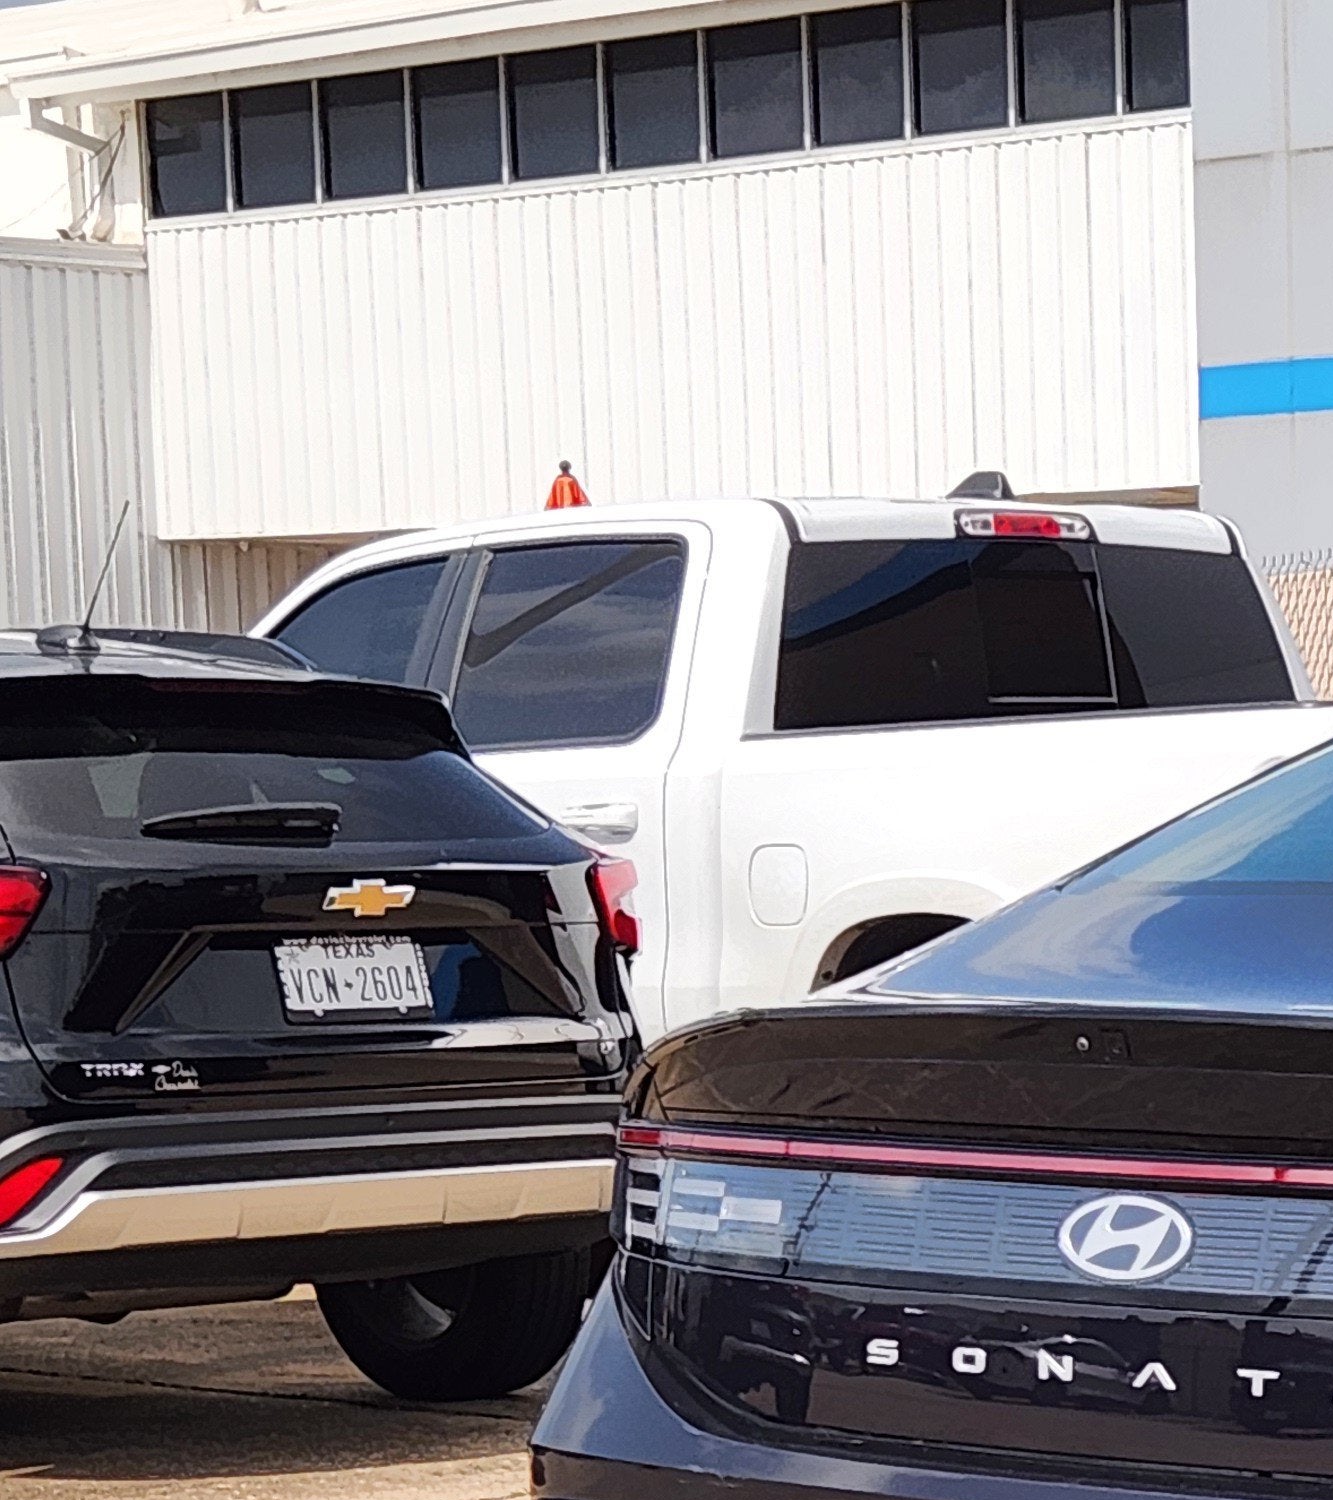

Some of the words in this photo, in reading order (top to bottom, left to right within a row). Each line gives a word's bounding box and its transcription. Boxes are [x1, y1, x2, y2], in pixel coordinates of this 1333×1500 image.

[323, 944, 375, 960] TEXAS
[289, 967, 340, 1004] VCN
[355, 965, 419, 1002] 2604
